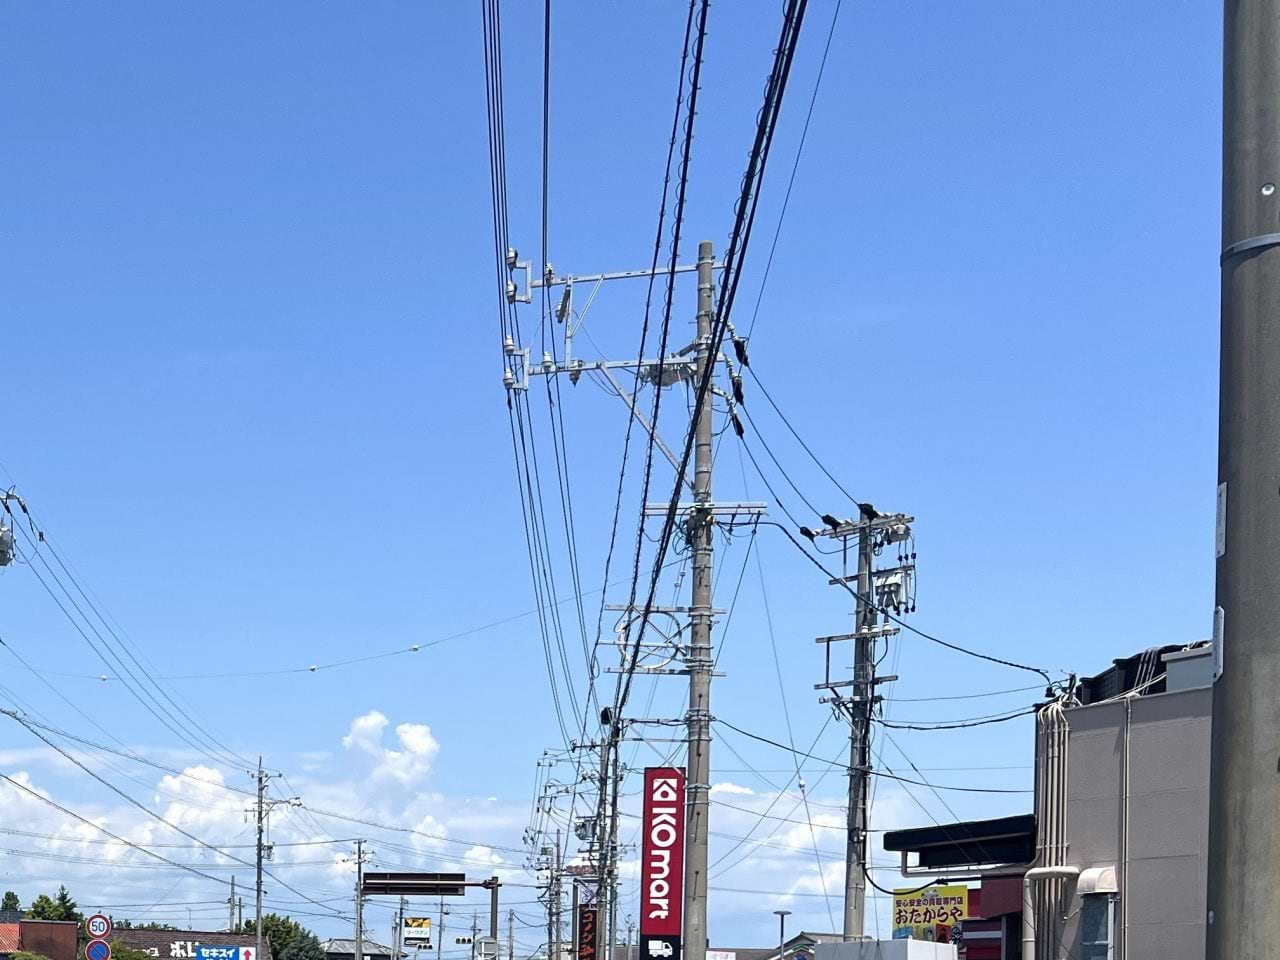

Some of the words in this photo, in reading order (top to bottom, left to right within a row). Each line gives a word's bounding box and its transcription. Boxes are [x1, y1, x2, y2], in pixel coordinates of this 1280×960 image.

[895, 906, 964, 924] おたからや
[91, 920, 105, 932] 50
[200, 948, 236, 958] セキスイ
